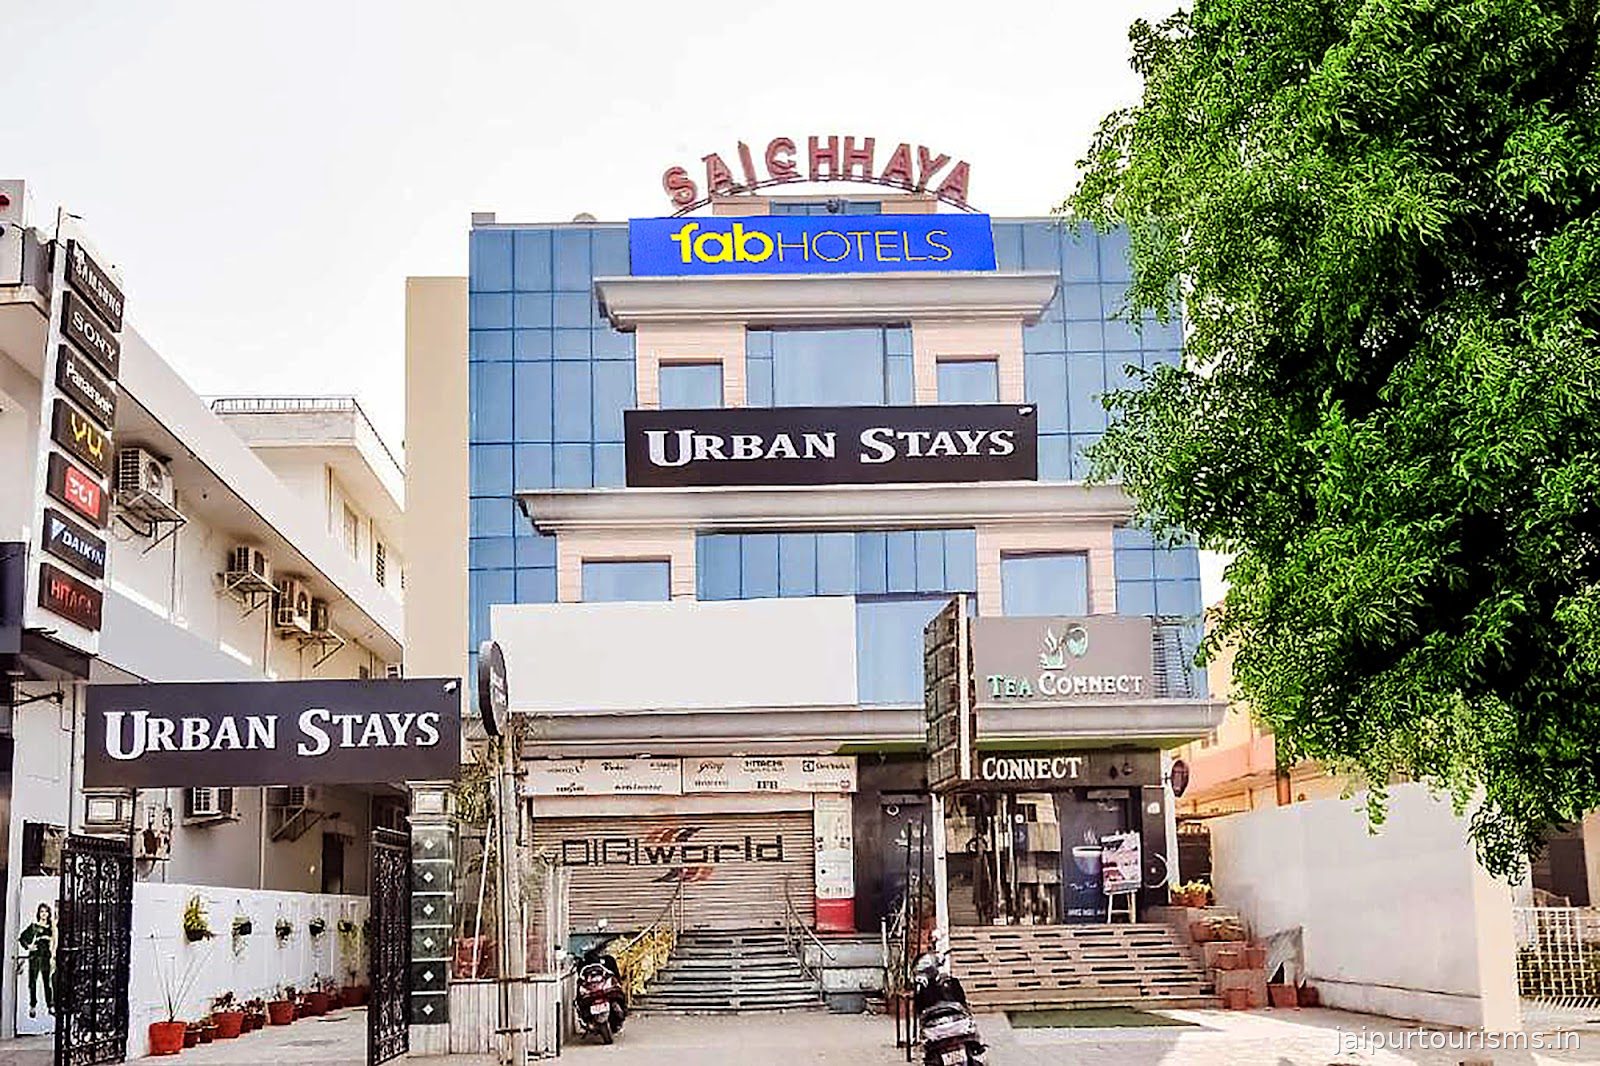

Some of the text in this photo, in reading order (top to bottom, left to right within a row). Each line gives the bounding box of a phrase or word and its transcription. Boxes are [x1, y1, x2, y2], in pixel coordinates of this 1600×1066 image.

[72, 311, 115, 362] SONY
[643, 427, 1015, 468] URBAN STAYS
[62, 531, 104, 564] DAIKIN
[987, 671, 1143, 698] TEA CONNECT
[103, 708, 440, 761] URBAN STAYS
[982, 757, 1082, 781] CONNECT
